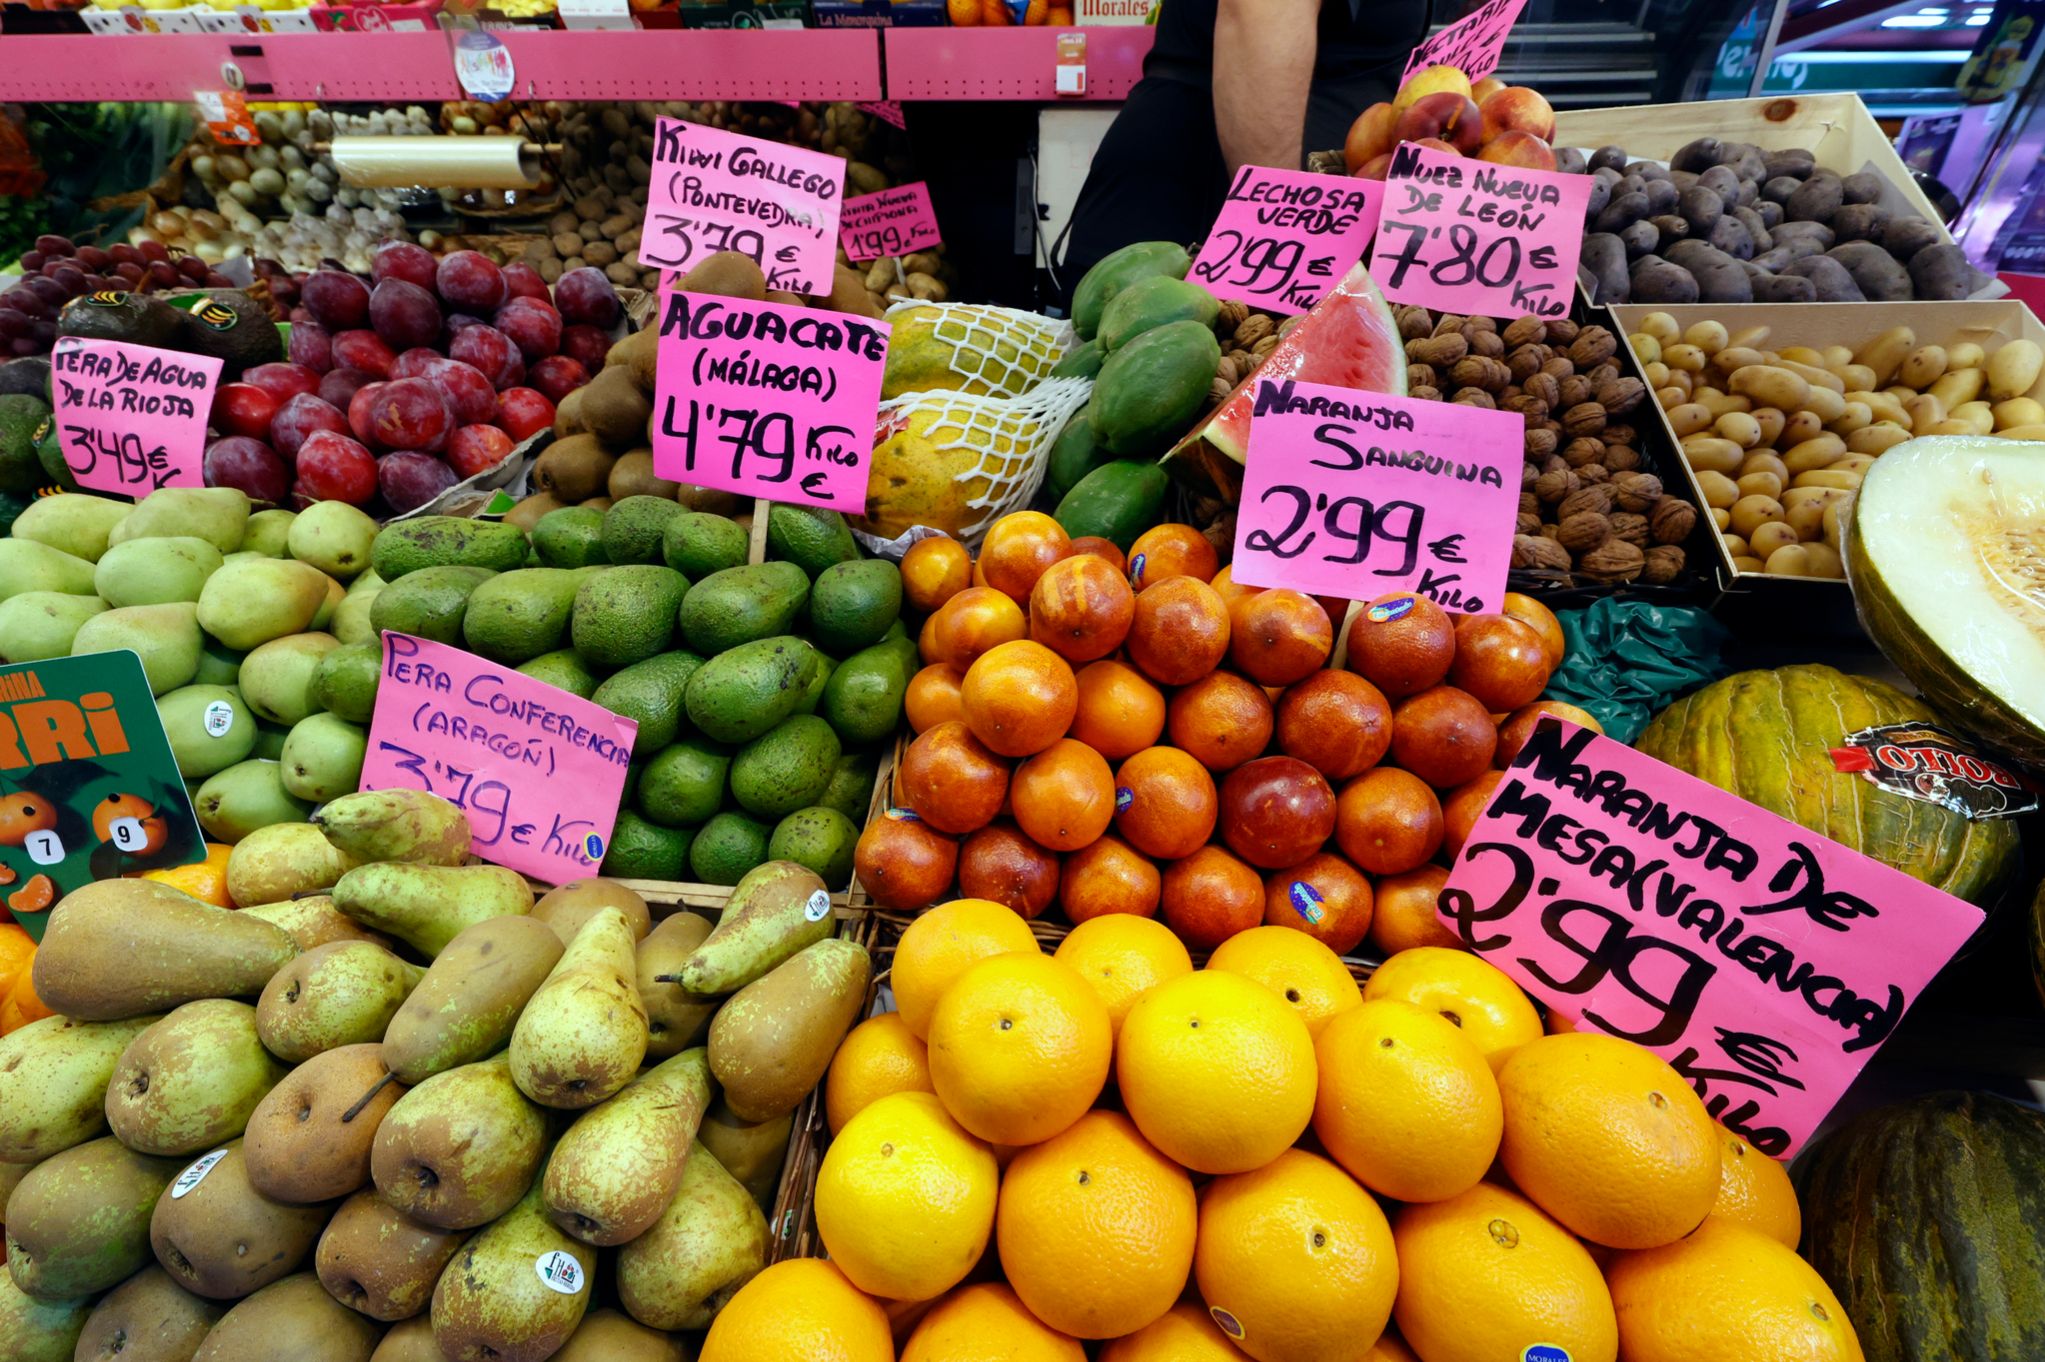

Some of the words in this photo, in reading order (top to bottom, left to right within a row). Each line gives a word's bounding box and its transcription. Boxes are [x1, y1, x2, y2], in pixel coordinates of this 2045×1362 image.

[655, 119, 723, 169] KIWI
[728, 146, 836, 200] GALLEGO
[1388, 146, 1463, 188] NUEZ
[1472, 167, 1560, 207] NUEVA
[1227, 168, 1366, 213] LECHOSA
[1397, 184, 1444, 214] DE
[850, 226, 902, 257] 1'99
[1257, 207, 1360, 235] VERDE
[774, 245, 802, 262] €
[1195, 230, 1306, 294] 2'99
[1377, 220, 1522, 290] 7'80
[660, 293, 886, 362] AGUACATE
[55, 340, 112, 379] PERA
[106, 350, 140, 387] DE
[140, 356, 208, 391] AGUA
[692, 347, 837, 402] (MÁLAGA)
[58, 379, 84, 409] DE
[88, 387, 115, 410] LA
[119, 388, 194, 419] RIOJA
[1253, 380, 1414, 432] NARANJA
[63, 425, 148, 484] 3'49
[147, 445, 169, 469] €
[662, 395, 795, 483] 4'79
[1309, 423, 1503, 489] SANGUINA
[799, 472, 835, 500] €
[1245, 484, 1425, 577] 2'99
[1427, 533, 1468, 564] €
[386, 633, 452, 693] PERA
[464, 674, 631, 768] CONFERENCIA
[412, 702, 556, 777] (ARAGÓN)
[1876, 744, 2022, 791] BOLLO
[38, 838, 51, 857] 7
[117, 825, 131, 844] 9
[511, 824, 537, 845] €
[1511, 718, 1758, 882] NARANJA
[1741, 841, 1880, 932] DE
[1437, 842, 1718, 1046] 2'99
[1714, 1026, 1806, 1091] €
